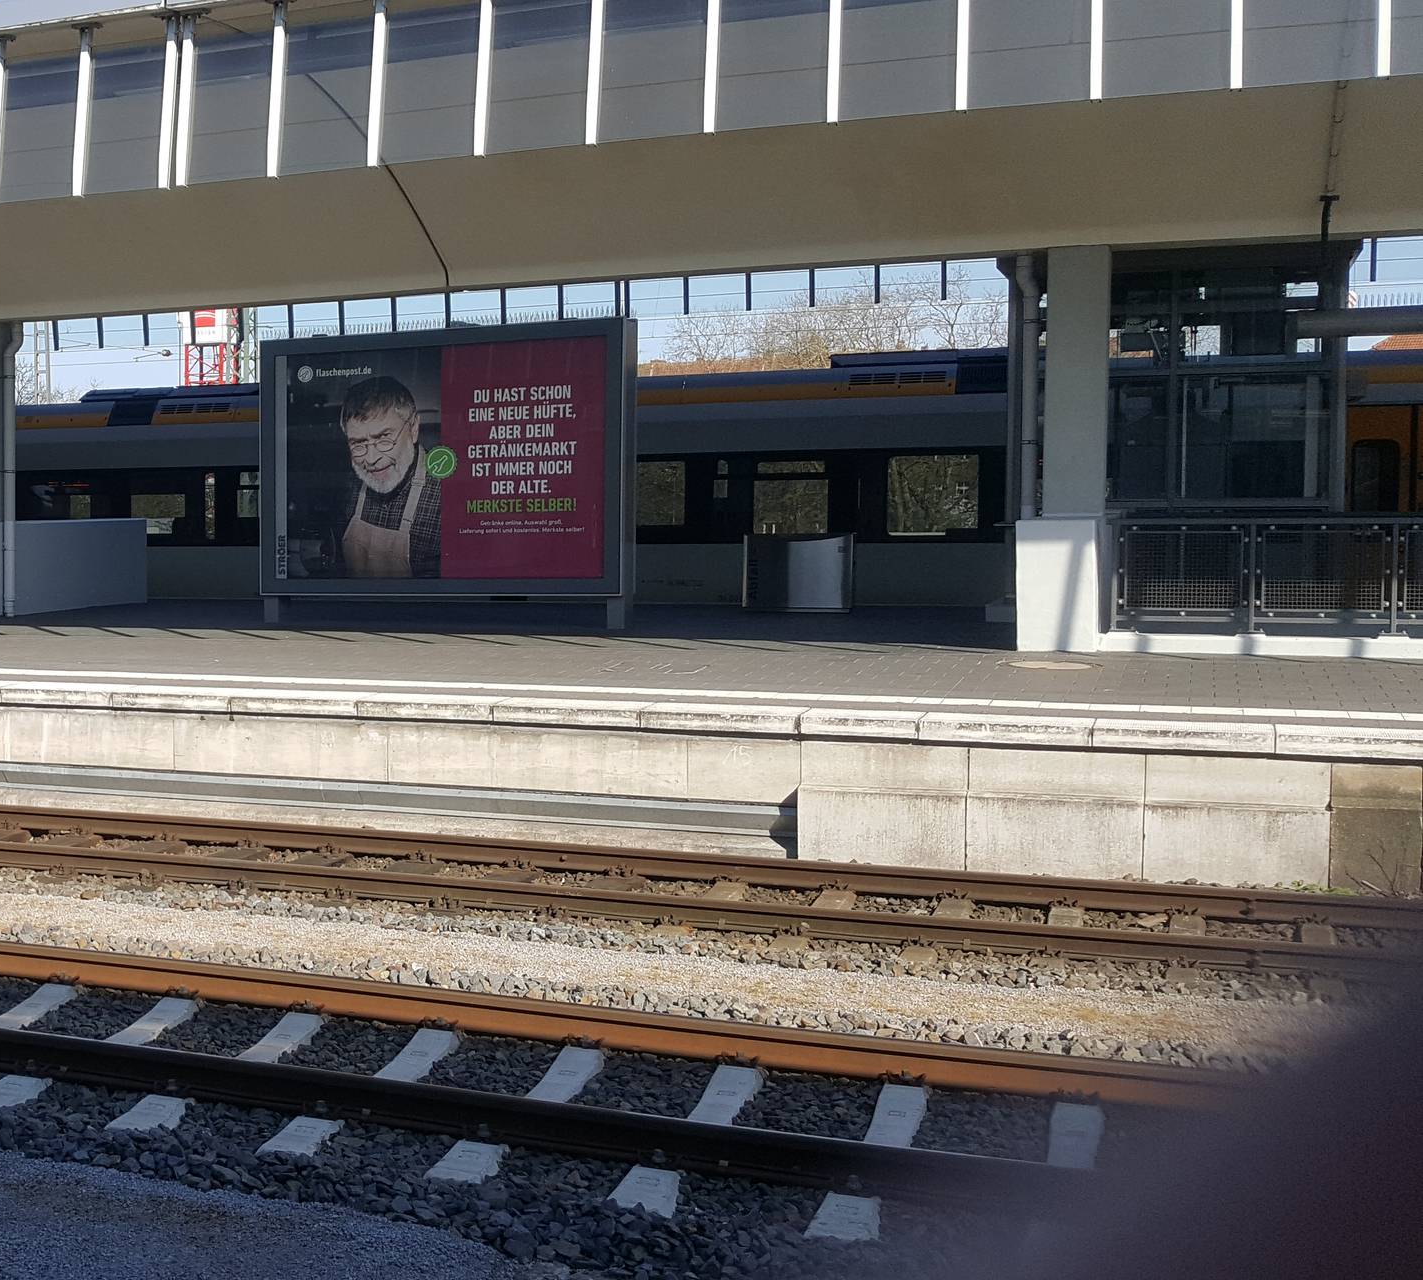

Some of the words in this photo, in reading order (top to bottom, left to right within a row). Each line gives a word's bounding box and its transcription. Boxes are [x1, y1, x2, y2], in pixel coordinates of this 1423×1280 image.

[316, 366, 372, 378] flaschenpost.de
[474, 390, 490, 403] DU
[494, 388, 526, 402] HAST
[530, 385, 571, 400] SCHON
[468, 408, 494, 422] EINE
[498, 406, 530, 420] NEUE
[534, 401, 576, 419] HÜFTE,
[489, 425, 521, 439] ABER
[526, 424, 554, 438] DEIN
[468, 440, 577, 458] GETRÄNKEMARKT
[472, 463, 491, 476] IST
[495, 462, 534, 476] IMMER
[539, 460, 572, 474] NOCH
[492, 481, 514, 494] DER
[518, 480, 552, 494] ALTE.
[466, 500, 522, 513] MERKSTE
[526, 498, 576, 512] SELBER!
[277, 534, 286, 576] STRÖER
